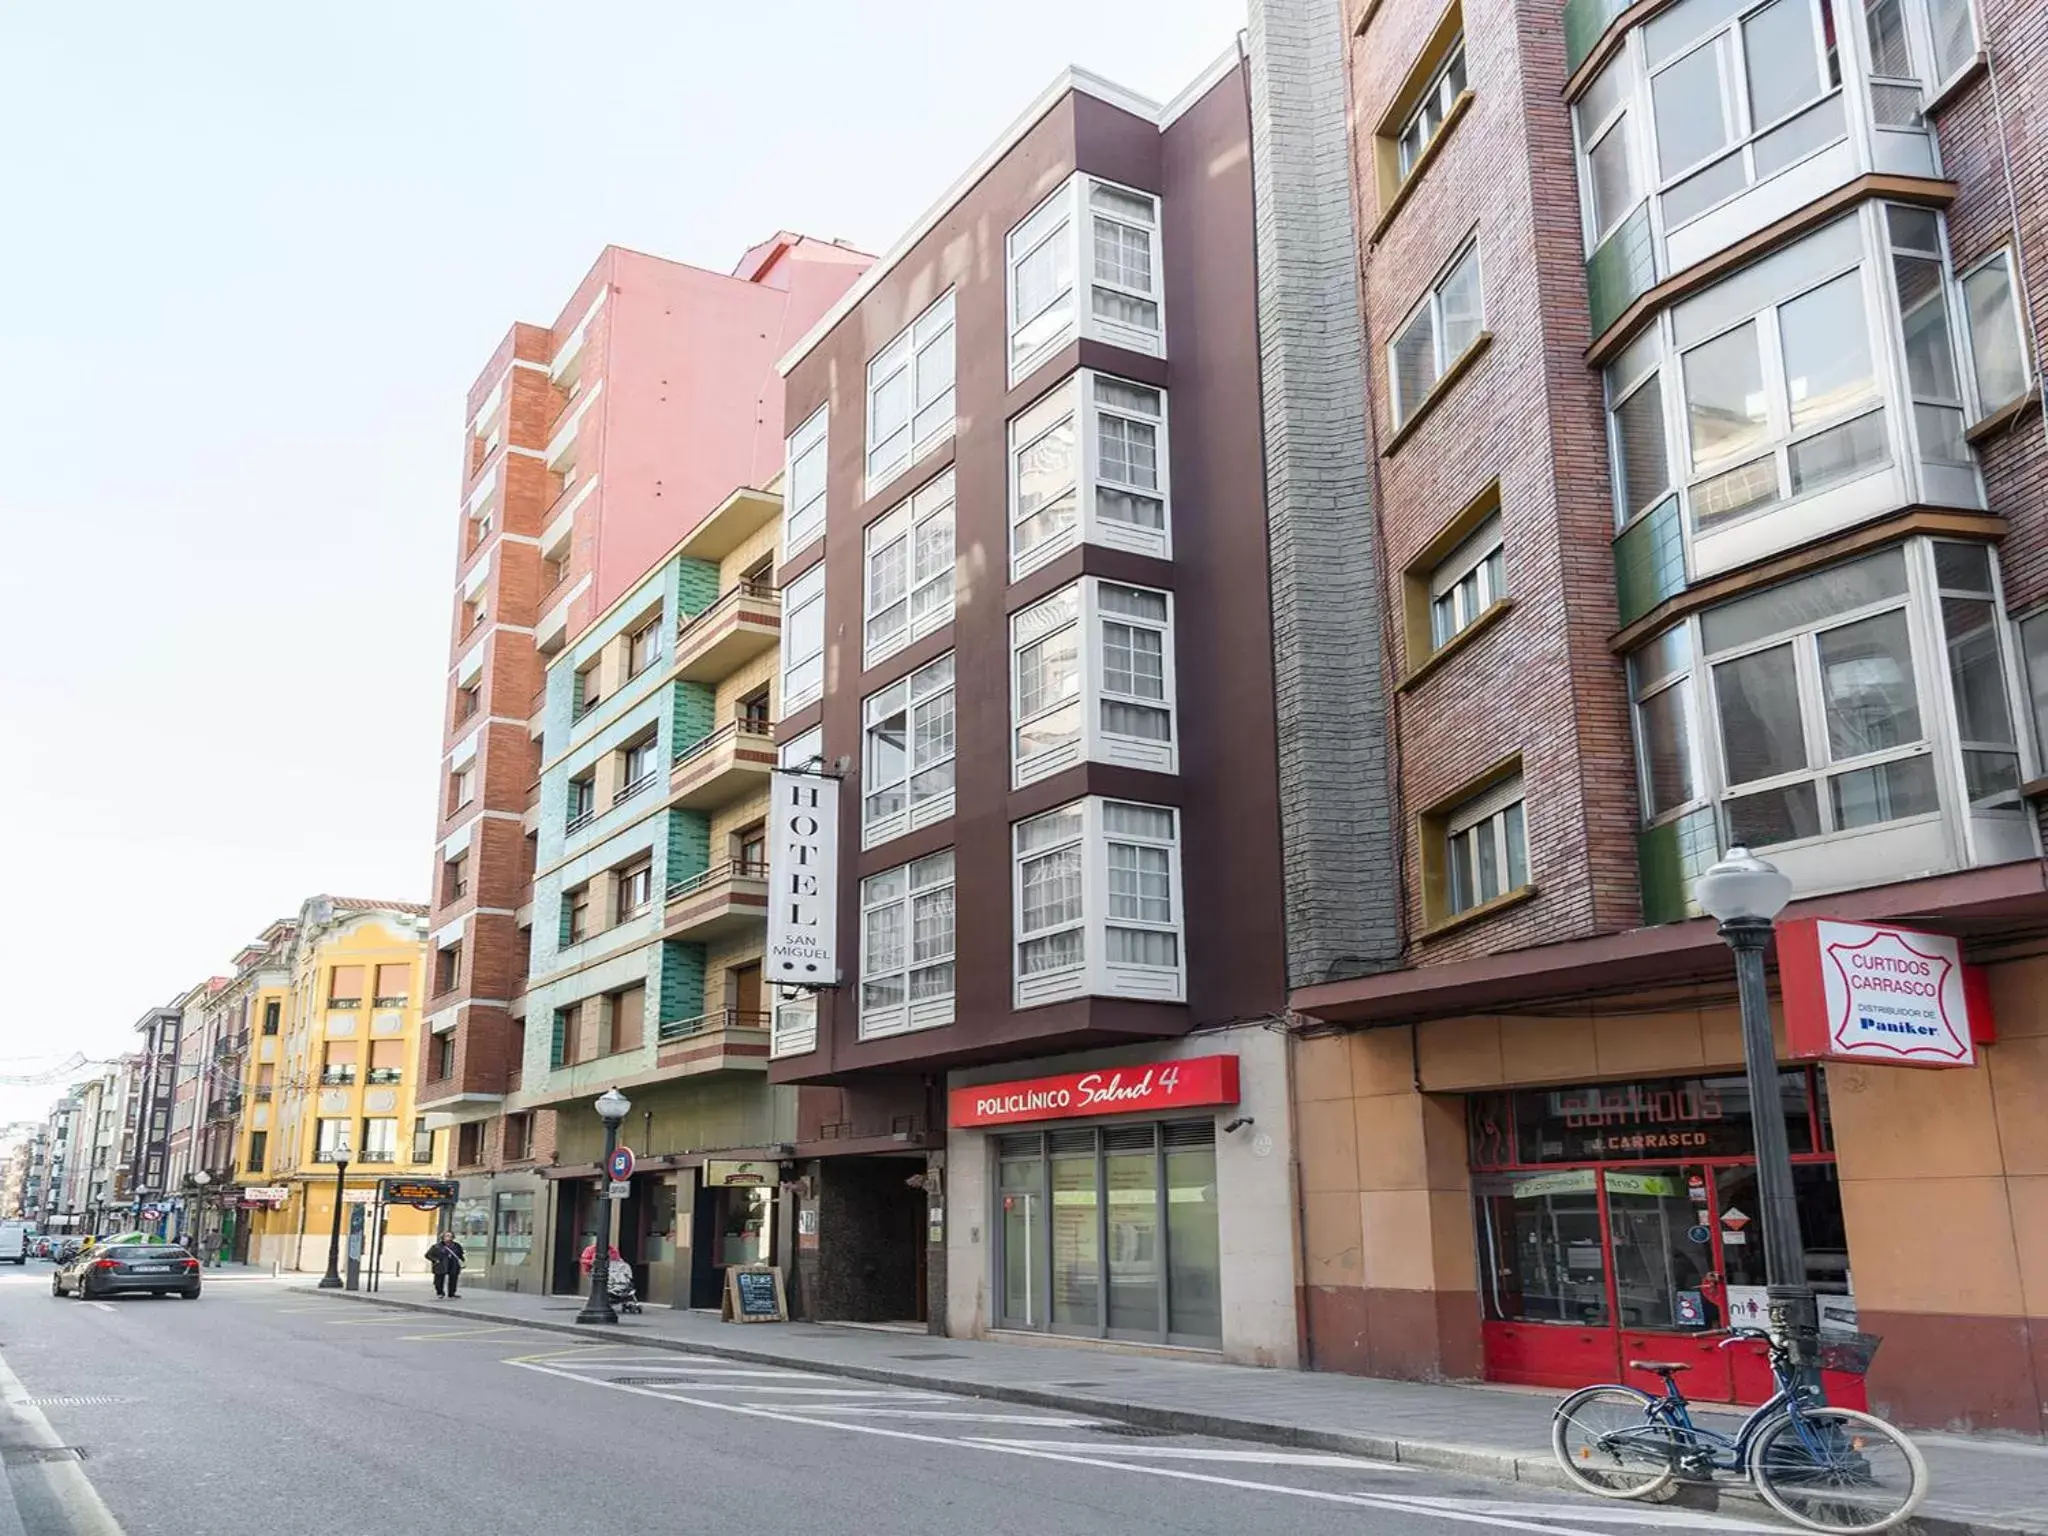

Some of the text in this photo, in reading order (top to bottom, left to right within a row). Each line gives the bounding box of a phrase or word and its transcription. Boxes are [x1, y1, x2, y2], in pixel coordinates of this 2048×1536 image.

[788, 786, 818, 926] HOTEL
[786, 934, 816, 946] SAN
[773, 945, 832, 960] MIGUEL
[1851, 953, 1931, 976] CURTIDOS
[1851, 974, 1936, 997] CARRASCO
[1857, 1003, 1936, 1019] DISTRIBUIDOR DE
[1859, 1017, 1938, 1036] Paniker
[976, 1066, 1180, 1117] POLICLÍNICO Salud 4
[1608, 1132, 1707, 1150] CARRASCO
